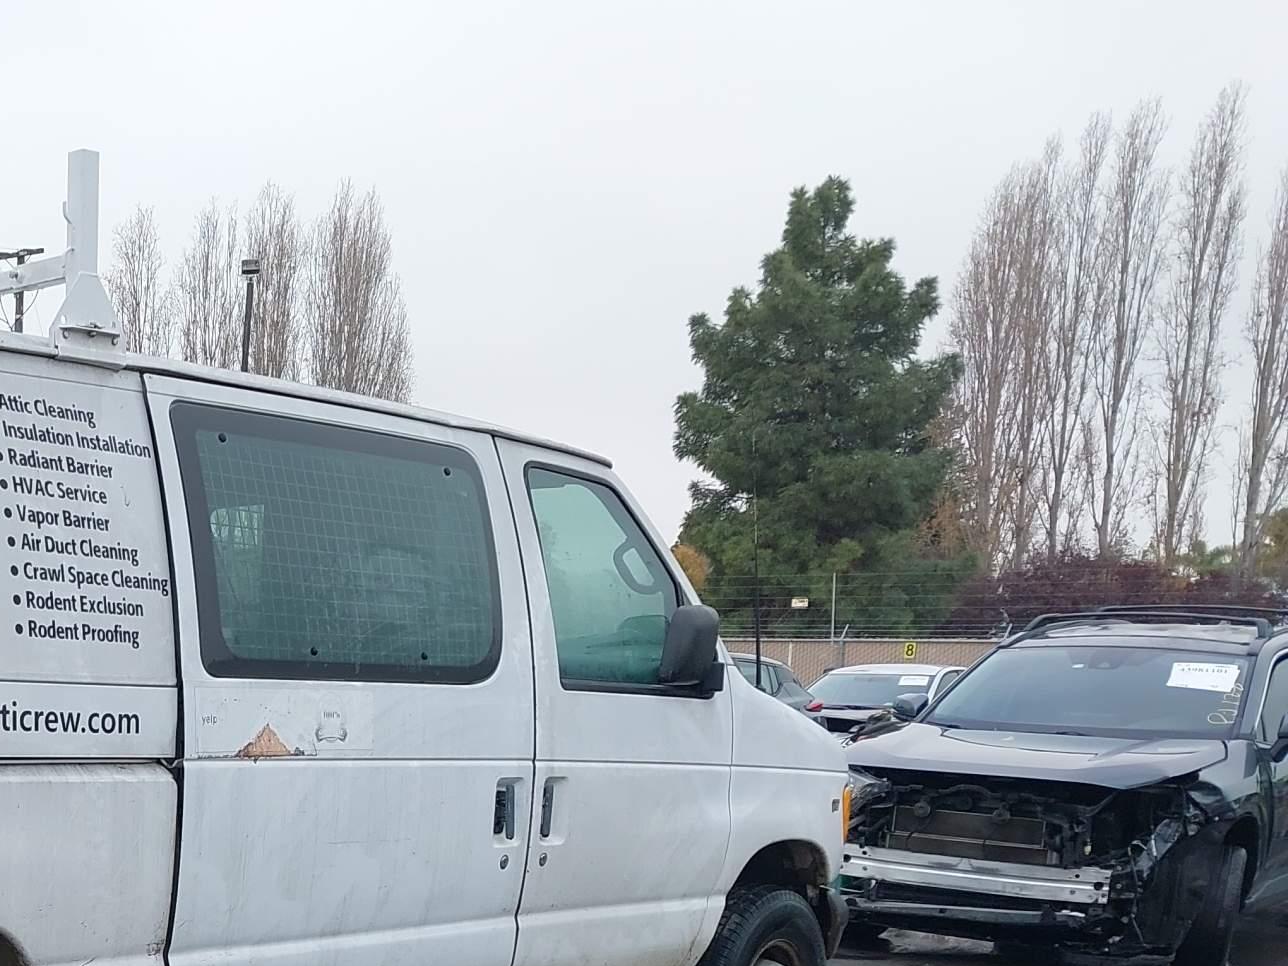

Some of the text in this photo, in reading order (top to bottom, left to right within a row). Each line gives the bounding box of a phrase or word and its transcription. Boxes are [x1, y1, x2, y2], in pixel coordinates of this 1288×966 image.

[0, 393, 97, 429] Attic Cleaning
[2, 420, 152, 458] Insulation Installation
[8, 448, 113, 479] Radiant Barrier
[12, 475, 108, 505] HVAC Service
[16, 504, 110, 532] Vapor Barrier
[21, 532, 140, 567] Air Duct Cleaning
[23, 562, 169, 597] Crawl Space Cleaning
[25, 590, 144, 617] Rodent Exclusion
[28, 620, 140, 649] Rodent Proofing
[905, 643, 915, 657] 8
[201, 714, 218, 727] yelp
